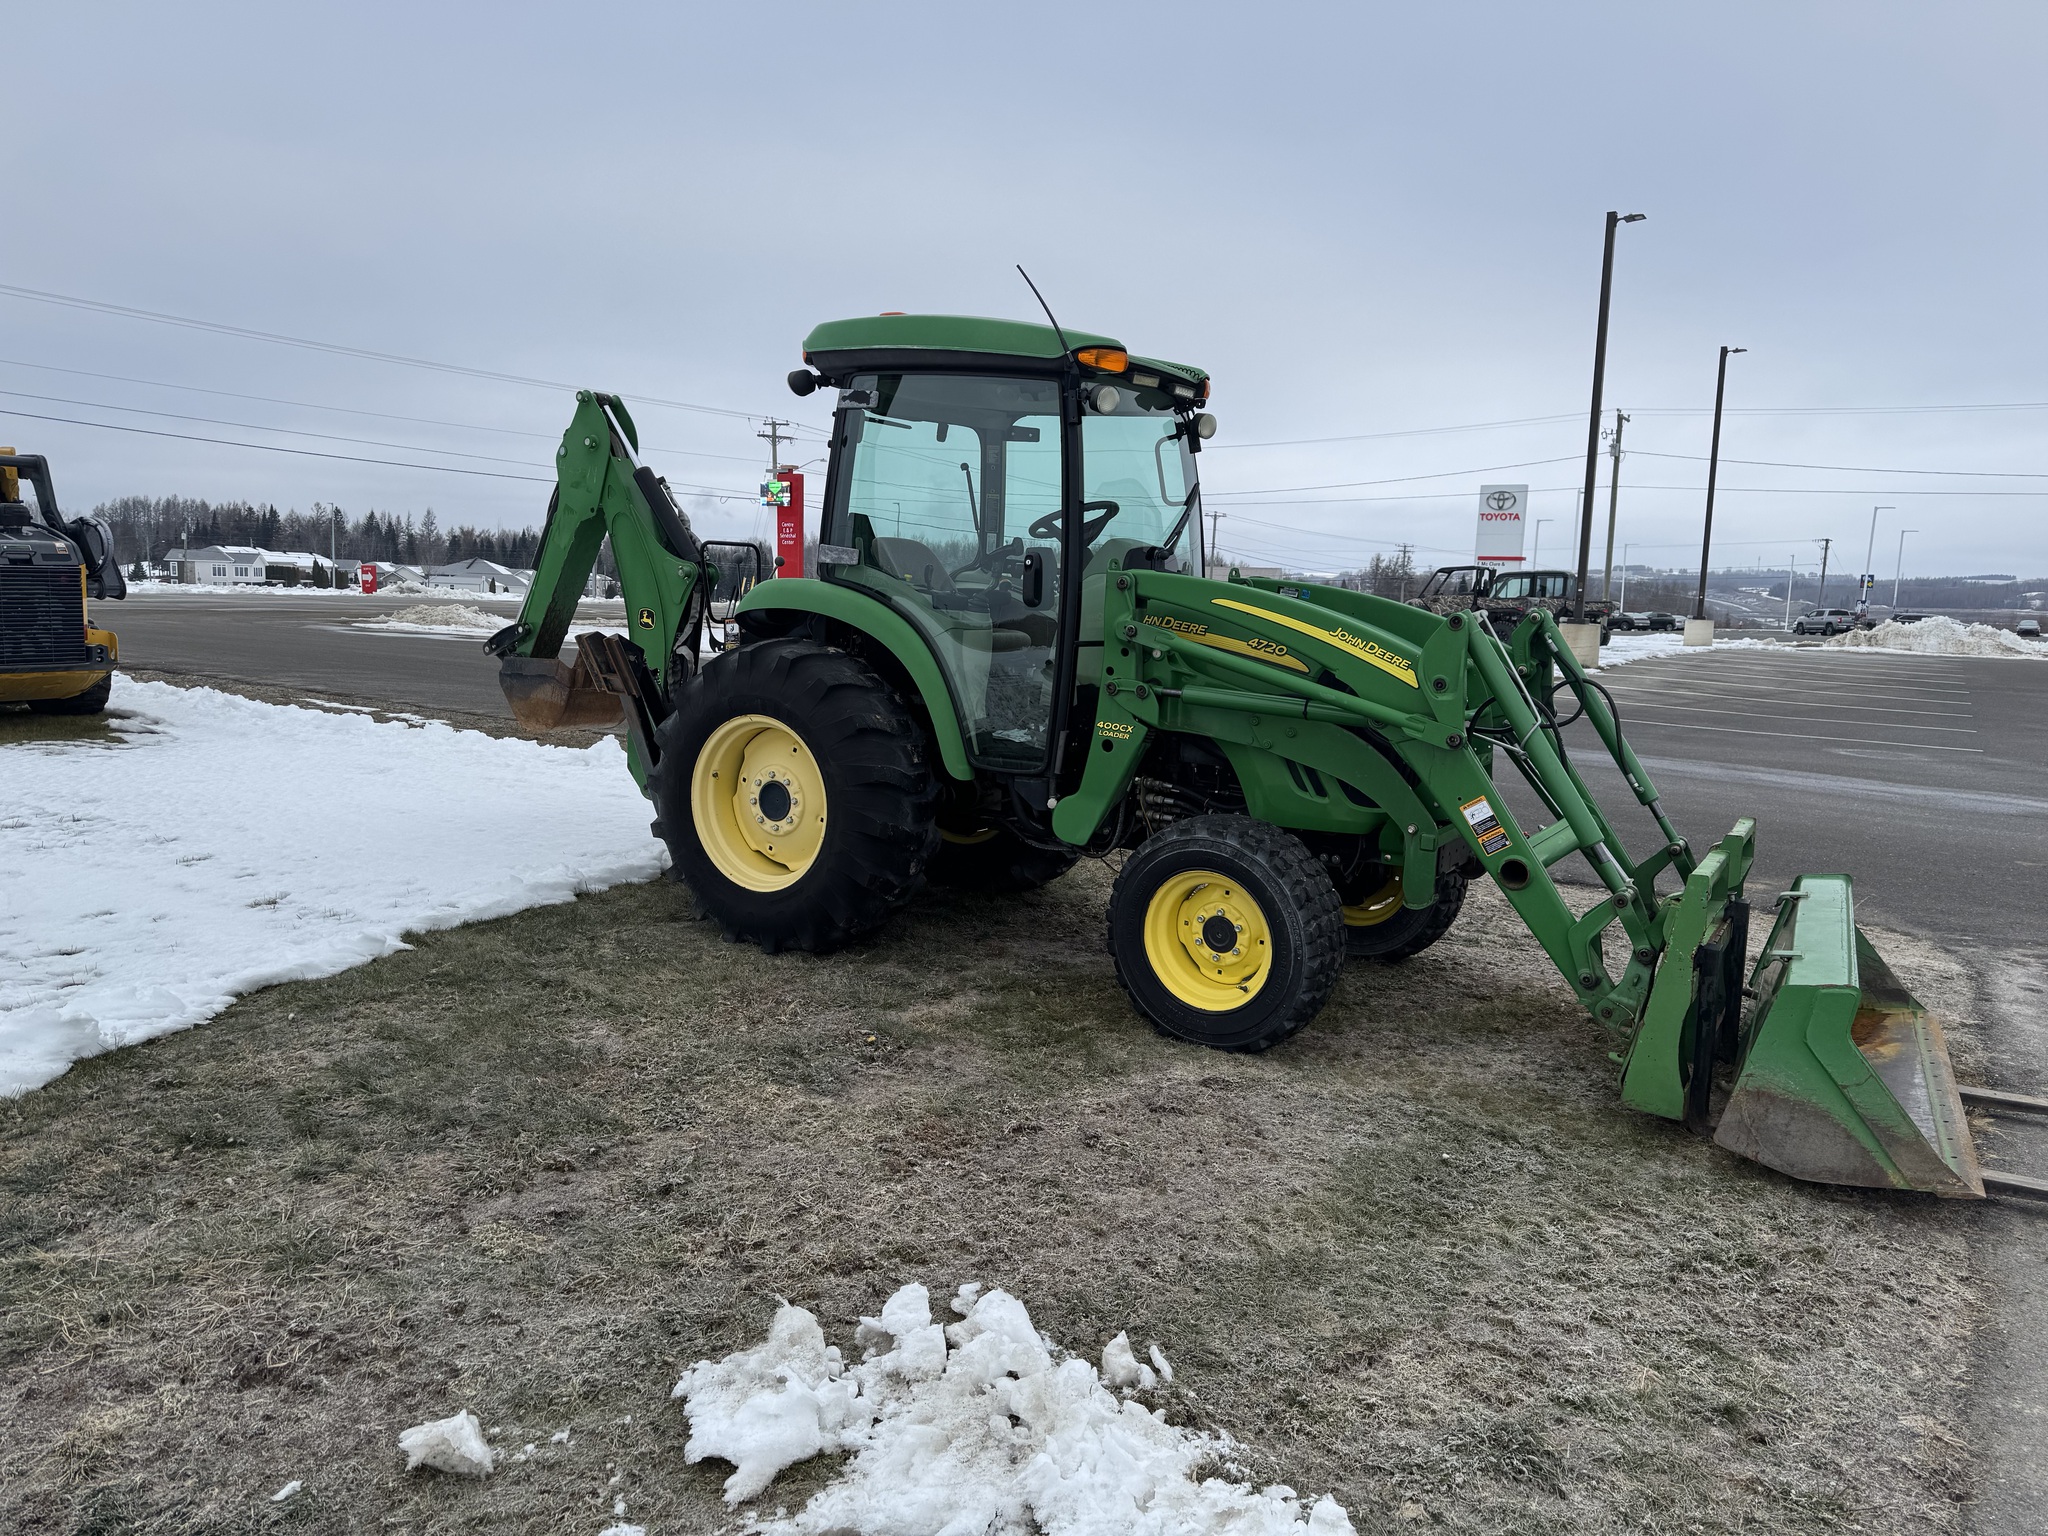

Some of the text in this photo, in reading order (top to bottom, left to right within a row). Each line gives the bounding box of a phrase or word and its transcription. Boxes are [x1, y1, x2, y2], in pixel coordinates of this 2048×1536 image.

[1480, 512, 1520, 521] TOYOTA
[1143, 614, 1208, 636] HN DEERE
[1247, 638, 1288, 656] 4720
[1329, 627, 1412, 670] JOHN DEERE
[1096, 721, 1134, 733] 400CX
[1098, 730, 1130, 739] LOADER
